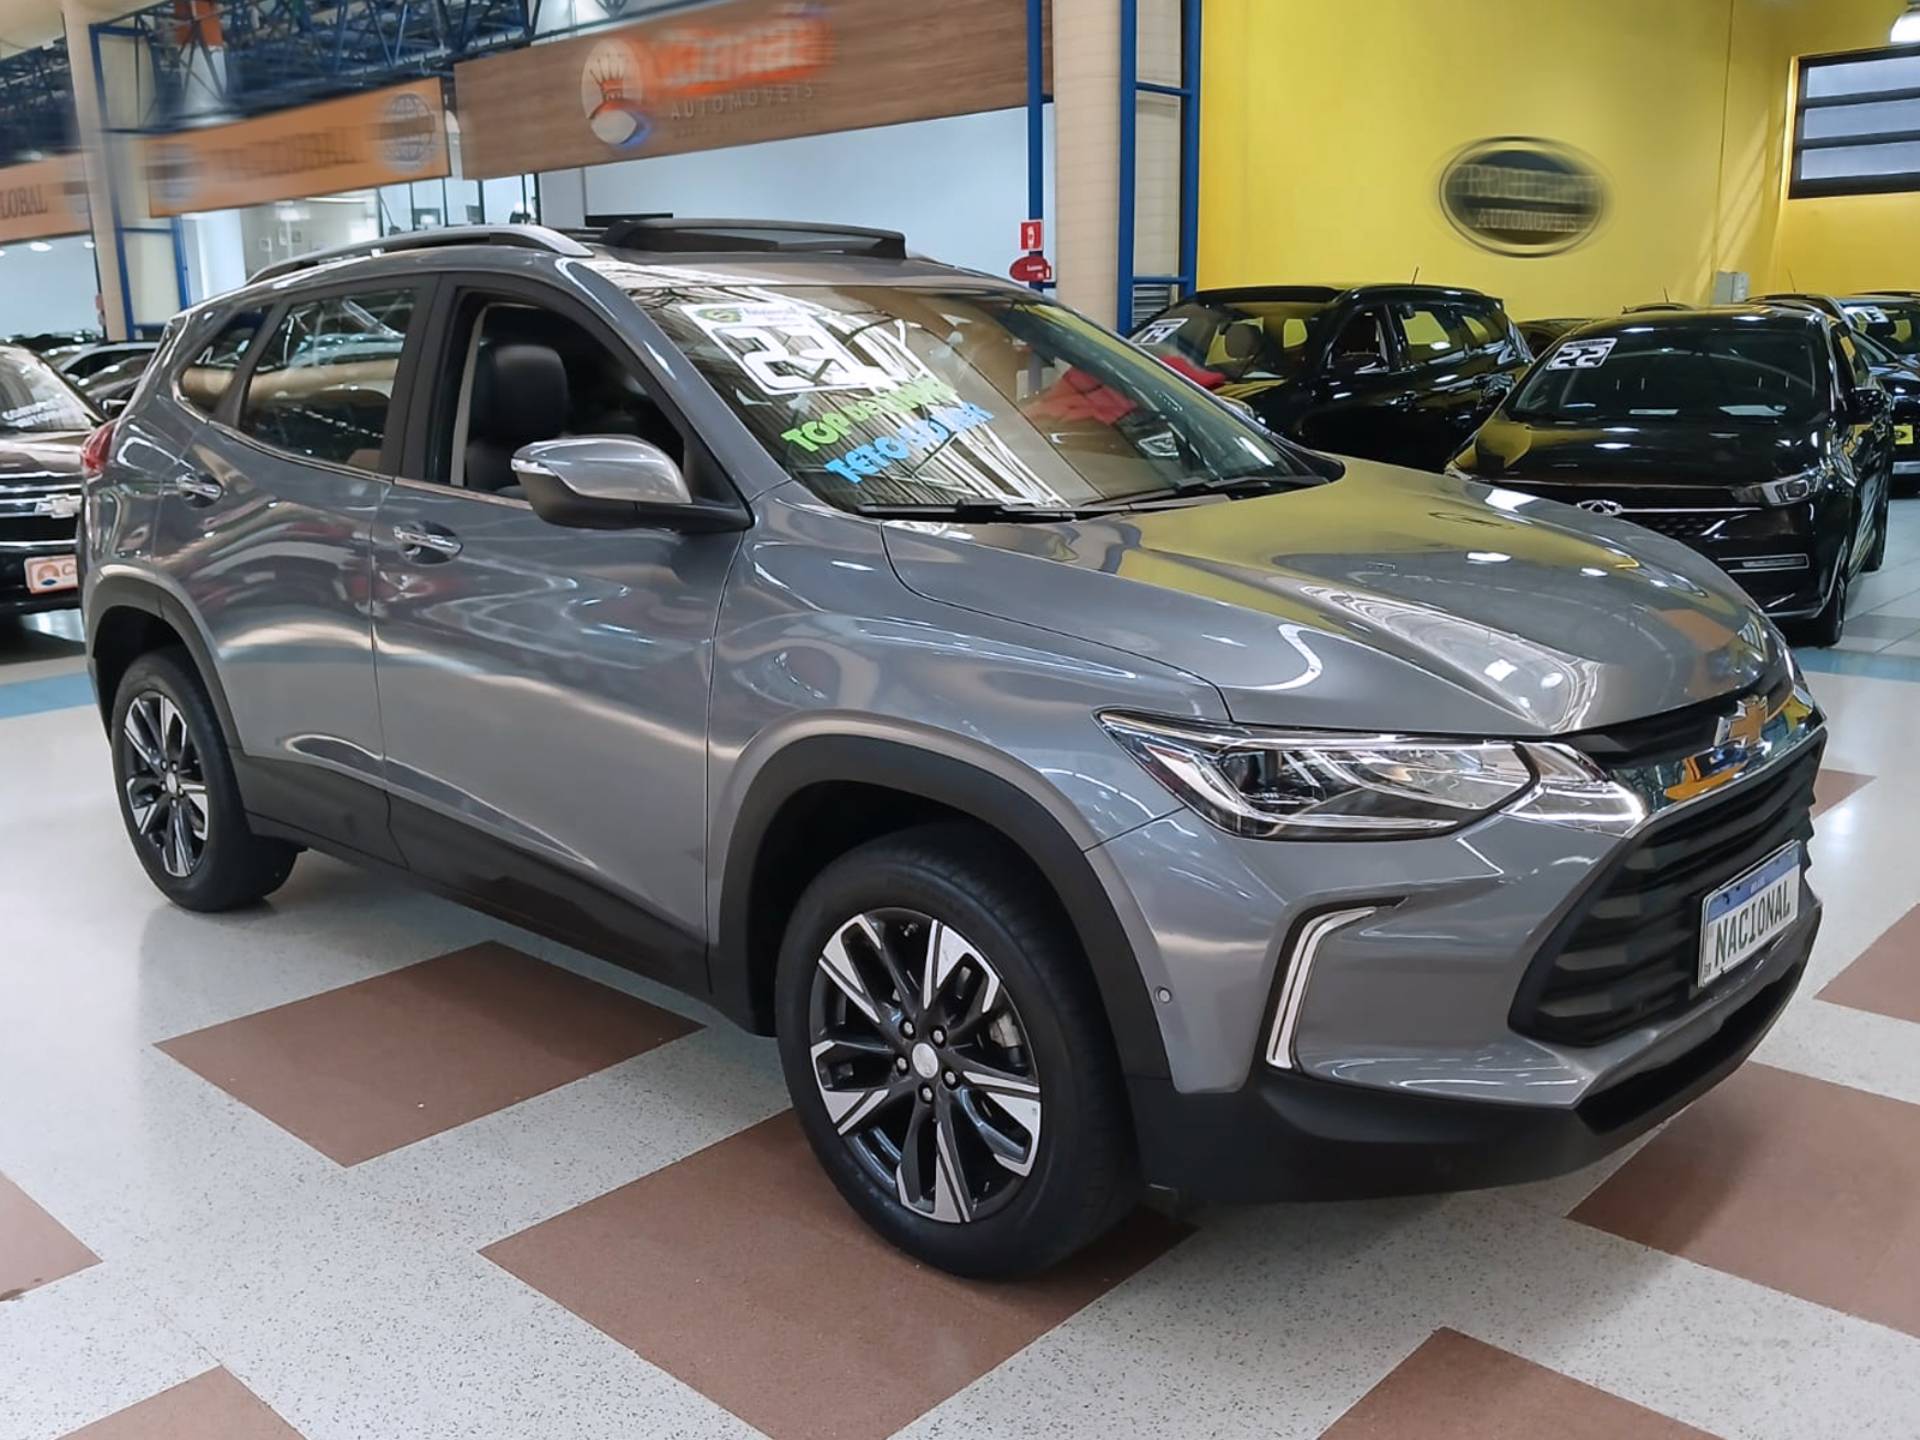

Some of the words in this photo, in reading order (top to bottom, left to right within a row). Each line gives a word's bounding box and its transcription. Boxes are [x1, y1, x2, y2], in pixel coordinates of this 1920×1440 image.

[1551, 347, 1608, 368] 22
[781, 412, 852, 452] TOP
[1714, 880, 1791, 969] NACIONAL
